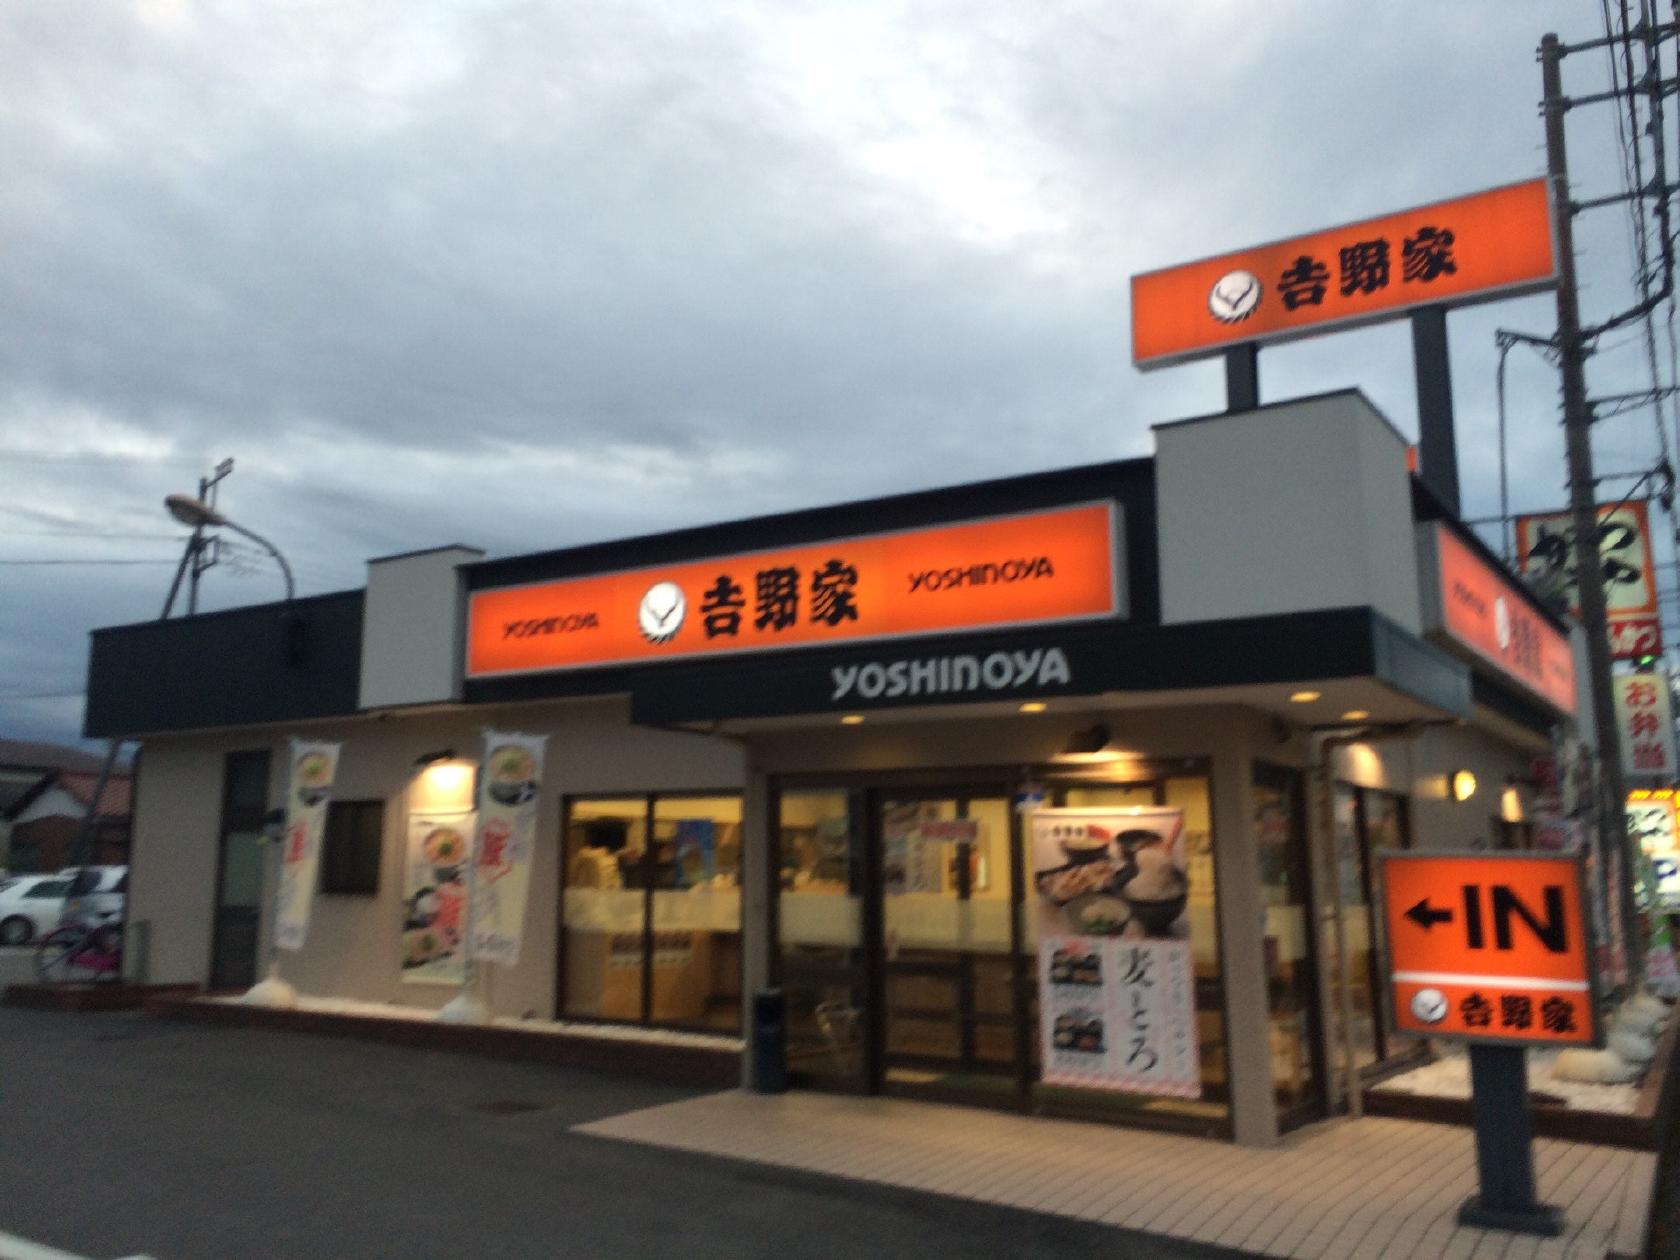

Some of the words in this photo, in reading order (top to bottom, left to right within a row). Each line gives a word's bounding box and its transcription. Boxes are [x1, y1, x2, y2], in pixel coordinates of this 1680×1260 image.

[907, 556, 1055, 593] YOSHINOYA
[830, 647, 1071, 700] YOSHINOYA
[1462, 884, 1569, 953] IN
